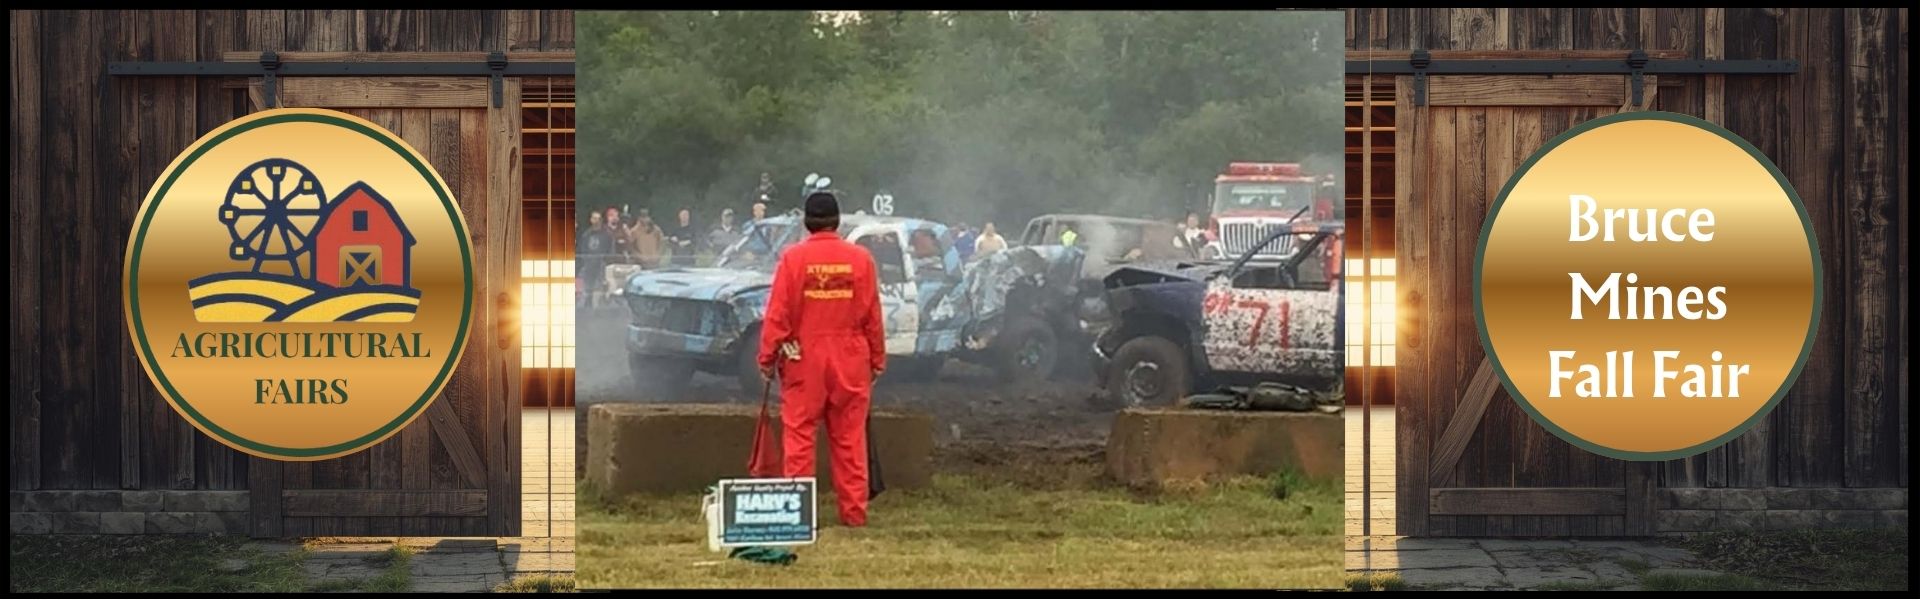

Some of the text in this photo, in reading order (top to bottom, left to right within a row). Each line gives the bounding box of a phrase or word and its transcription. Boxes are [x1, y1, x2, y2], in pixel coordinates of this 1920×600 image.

[873, 194, 894, 215] 03
[1236, 300, 1290, 351] 71
[736, 493, 801, 511] HARV'S
